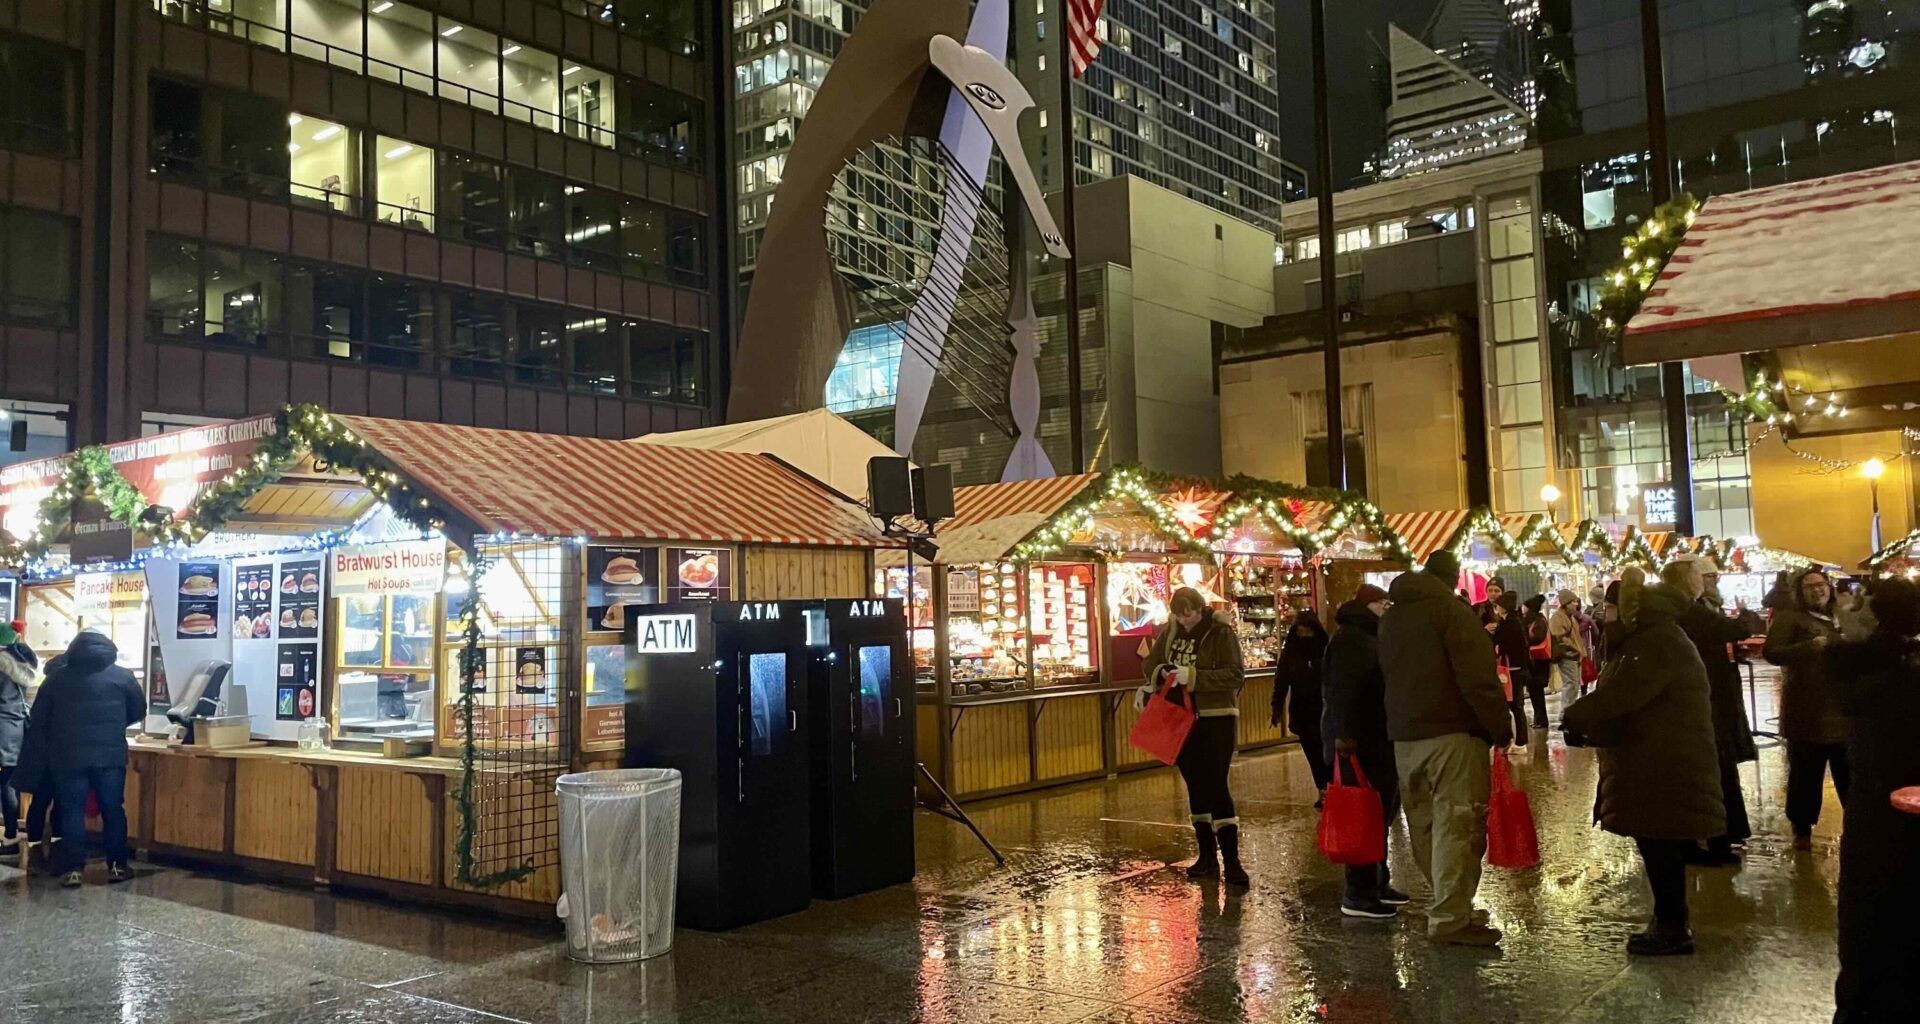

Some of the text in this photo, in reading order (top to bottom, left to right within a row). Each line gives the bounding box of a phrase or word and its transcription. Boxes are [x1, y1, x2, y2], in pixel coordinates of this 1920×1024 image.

[337, 549, 443, 572] Bratwurst House
[80, 577, 145, 596] Pancake House
[368, 578, 381, 590] Hot
[383, 577, 411, 591] Soups
[96, 600, 108, 610] Hot
[739, 603, 780, 620] ATM
[849, 600, 885, 616] ATM
[643, 619, 692, 649] ATM
